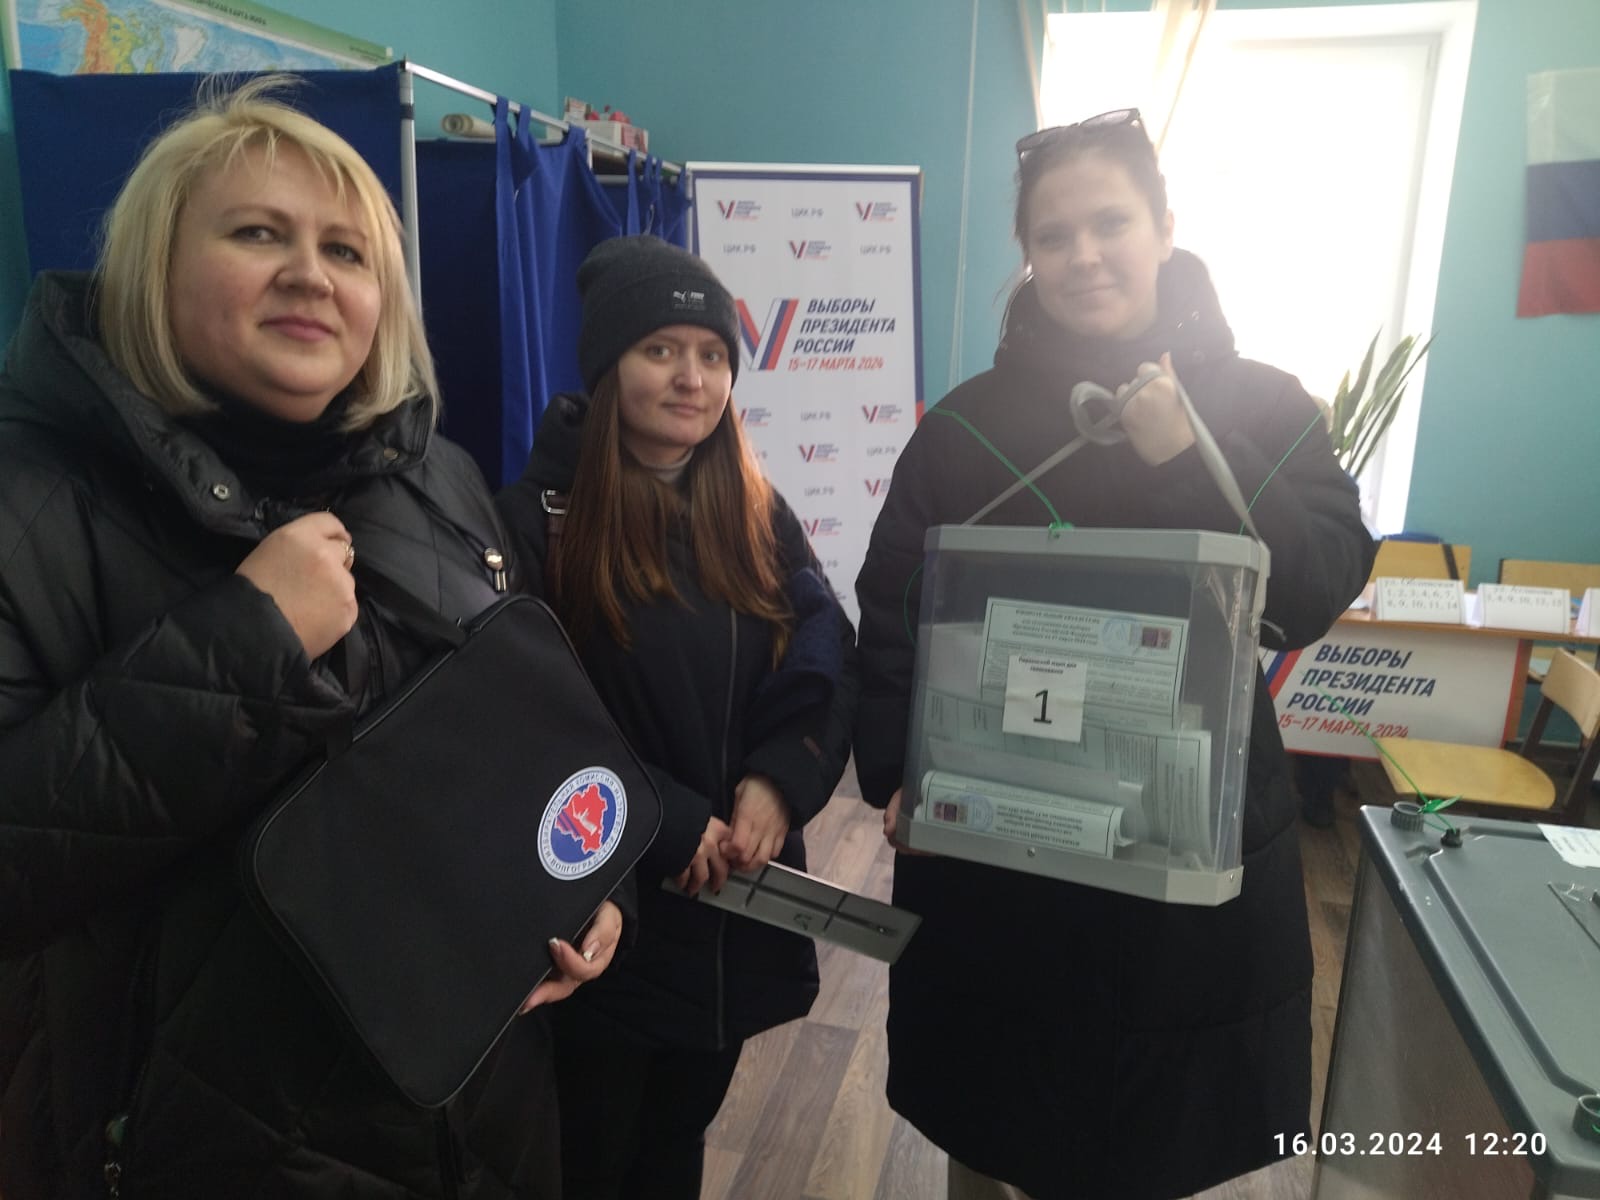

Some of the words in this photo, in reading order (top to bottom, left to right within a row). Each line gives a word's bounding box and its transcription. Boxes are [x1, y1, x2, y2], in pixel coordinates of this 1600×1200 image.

[807, 299, 876, 314] ВЫБОРЫ
[800, 318, 896, 335] ПРЕЗИДЕНТА
[793, 338, 856, 354] РОССИИ
[819, 358, 856, 371] МАРТА
[857, 357, 884, 370] 2024
[1314, 643, 1413, 669] ВЫБОРЫ
[1300, 668, 1437, 697] ПРЕЗИДЕНТА
[1033, 689, 1052, 724] 1
[1287, 692, 1375, 716] РОССИИ
[1319, 717, 1371, 737] МАРТА
[1371, 723, 1409, 738] 2024
